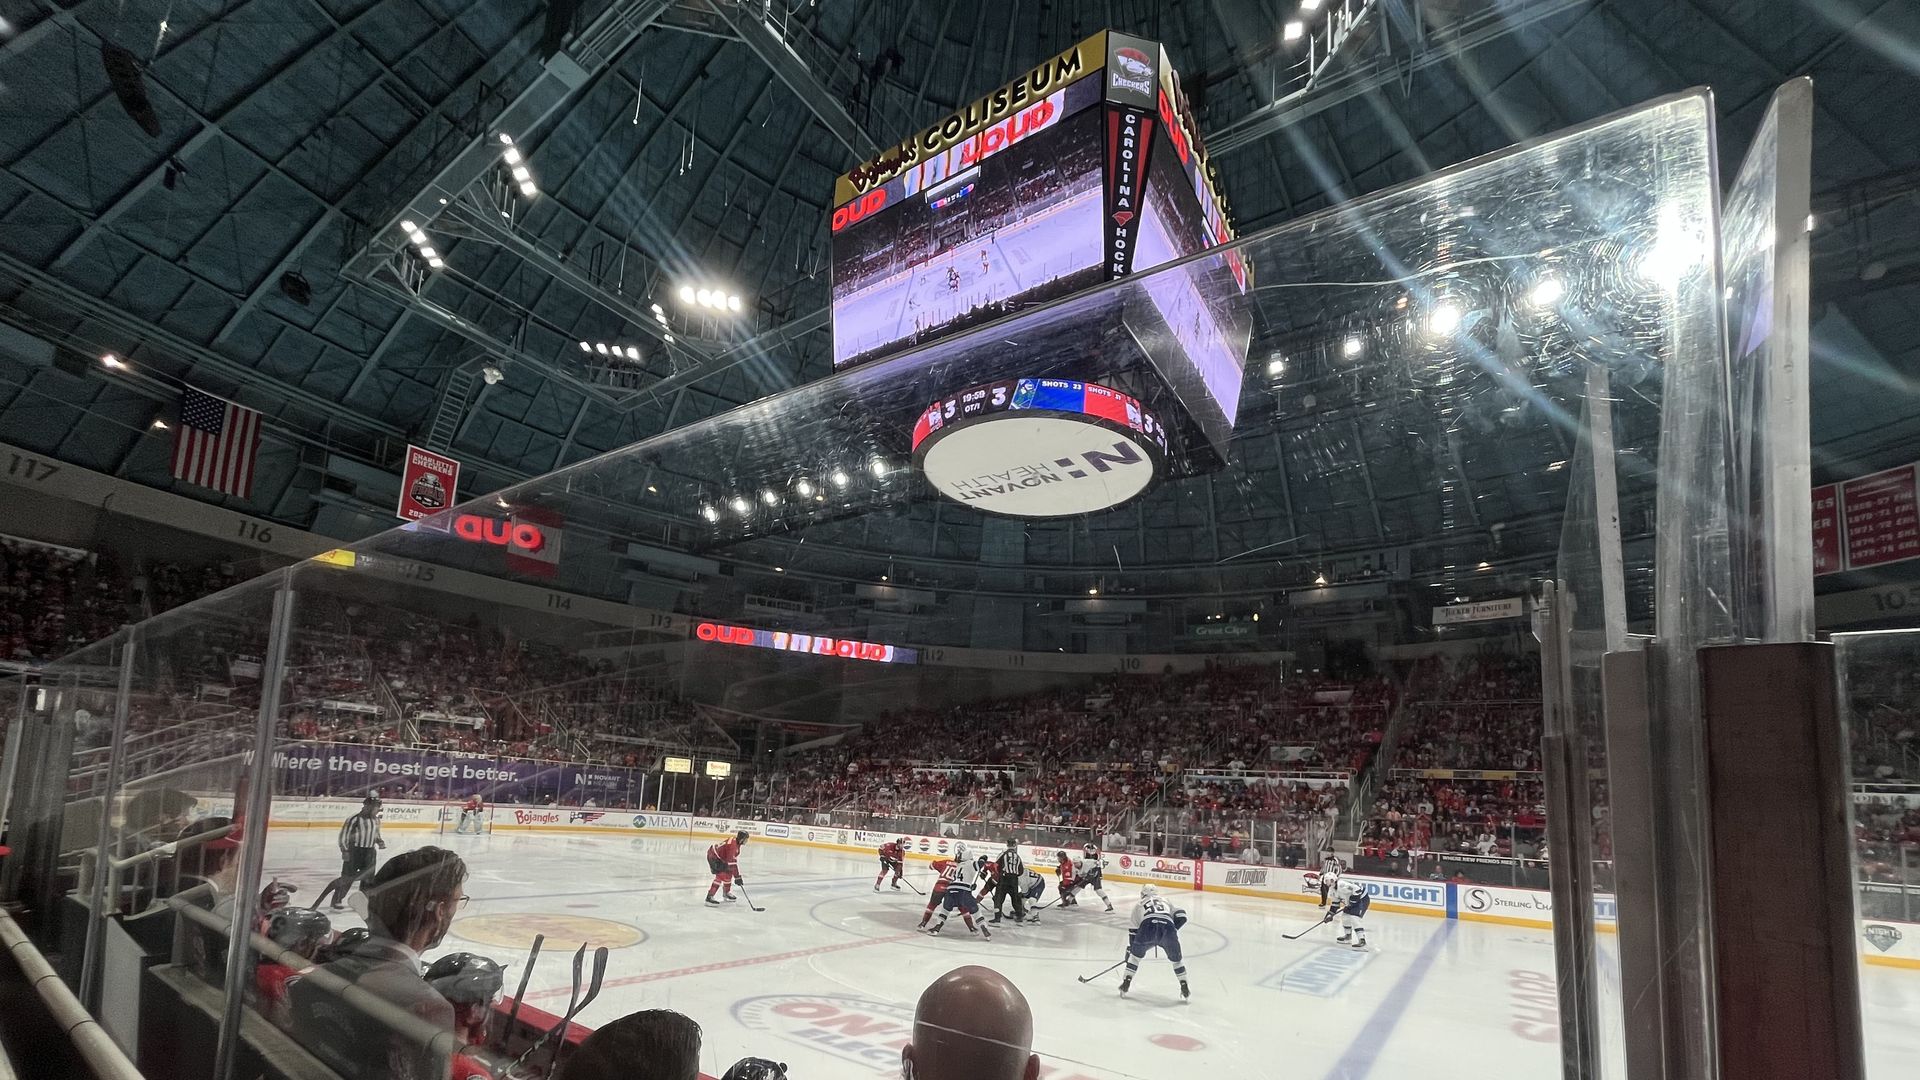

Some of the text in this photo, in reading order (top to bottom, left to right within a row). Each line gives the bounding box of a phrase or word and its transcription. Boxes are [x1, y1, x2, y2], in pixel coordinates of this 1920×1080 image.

[1113, 73, 1150, 95] CHECKERS
[922, 47, 1082, 150] COLISEUM
[961, 100, 1055, 165] LOUD
[1118, 114, 1136, 207] CAROLINA
[1113, 227, 1127, 280] HOCK
[1042, 381, 1068, 389] SHOTS
[1088, 386, 1111, 397] SHOTS
[991, 387, 1006, 406] 3
[944, 400, 956, 419] 3
[1144, 413, 1153, 433] 3
[8, 453, 61, 482] 117
[412, 457, 453, 476] CHECKERS
[413, 452, 454, 470] CHARLOTTE
[951, 463, 1053, 491] HEALTH
[963, 473, 1063, 500] NOVANT
[238, 519, 272, 544] 116
[547, 593, 571, 610] 114
[1472, 603, 1512, 614] FURNITURE
[650, 614, 672, 629] 113
[1196, 625, 1248, 637] Great Clips
[820, 637, 887, 661] LOUD
[925, 648, 944, 661] 112
[1008, 655, 1024, 667] 111
[1120, 658, 1140, 671] 110
[328, 755, 368, 773] the
[373, 758, 421, 776] best
[425, 763, 458, 781] get
[462, 766, 519, 783] better.
[594, 774, 621, 782] NOVANT
[514, 809, 560, 826] Bojangles
[648, 815, 688, 829] MEMA
[1134, 859, 1146, 868] LG
[1383, 885, 1440, 902] LIGHT
[1494, 897, 1532, 909] STERLING
